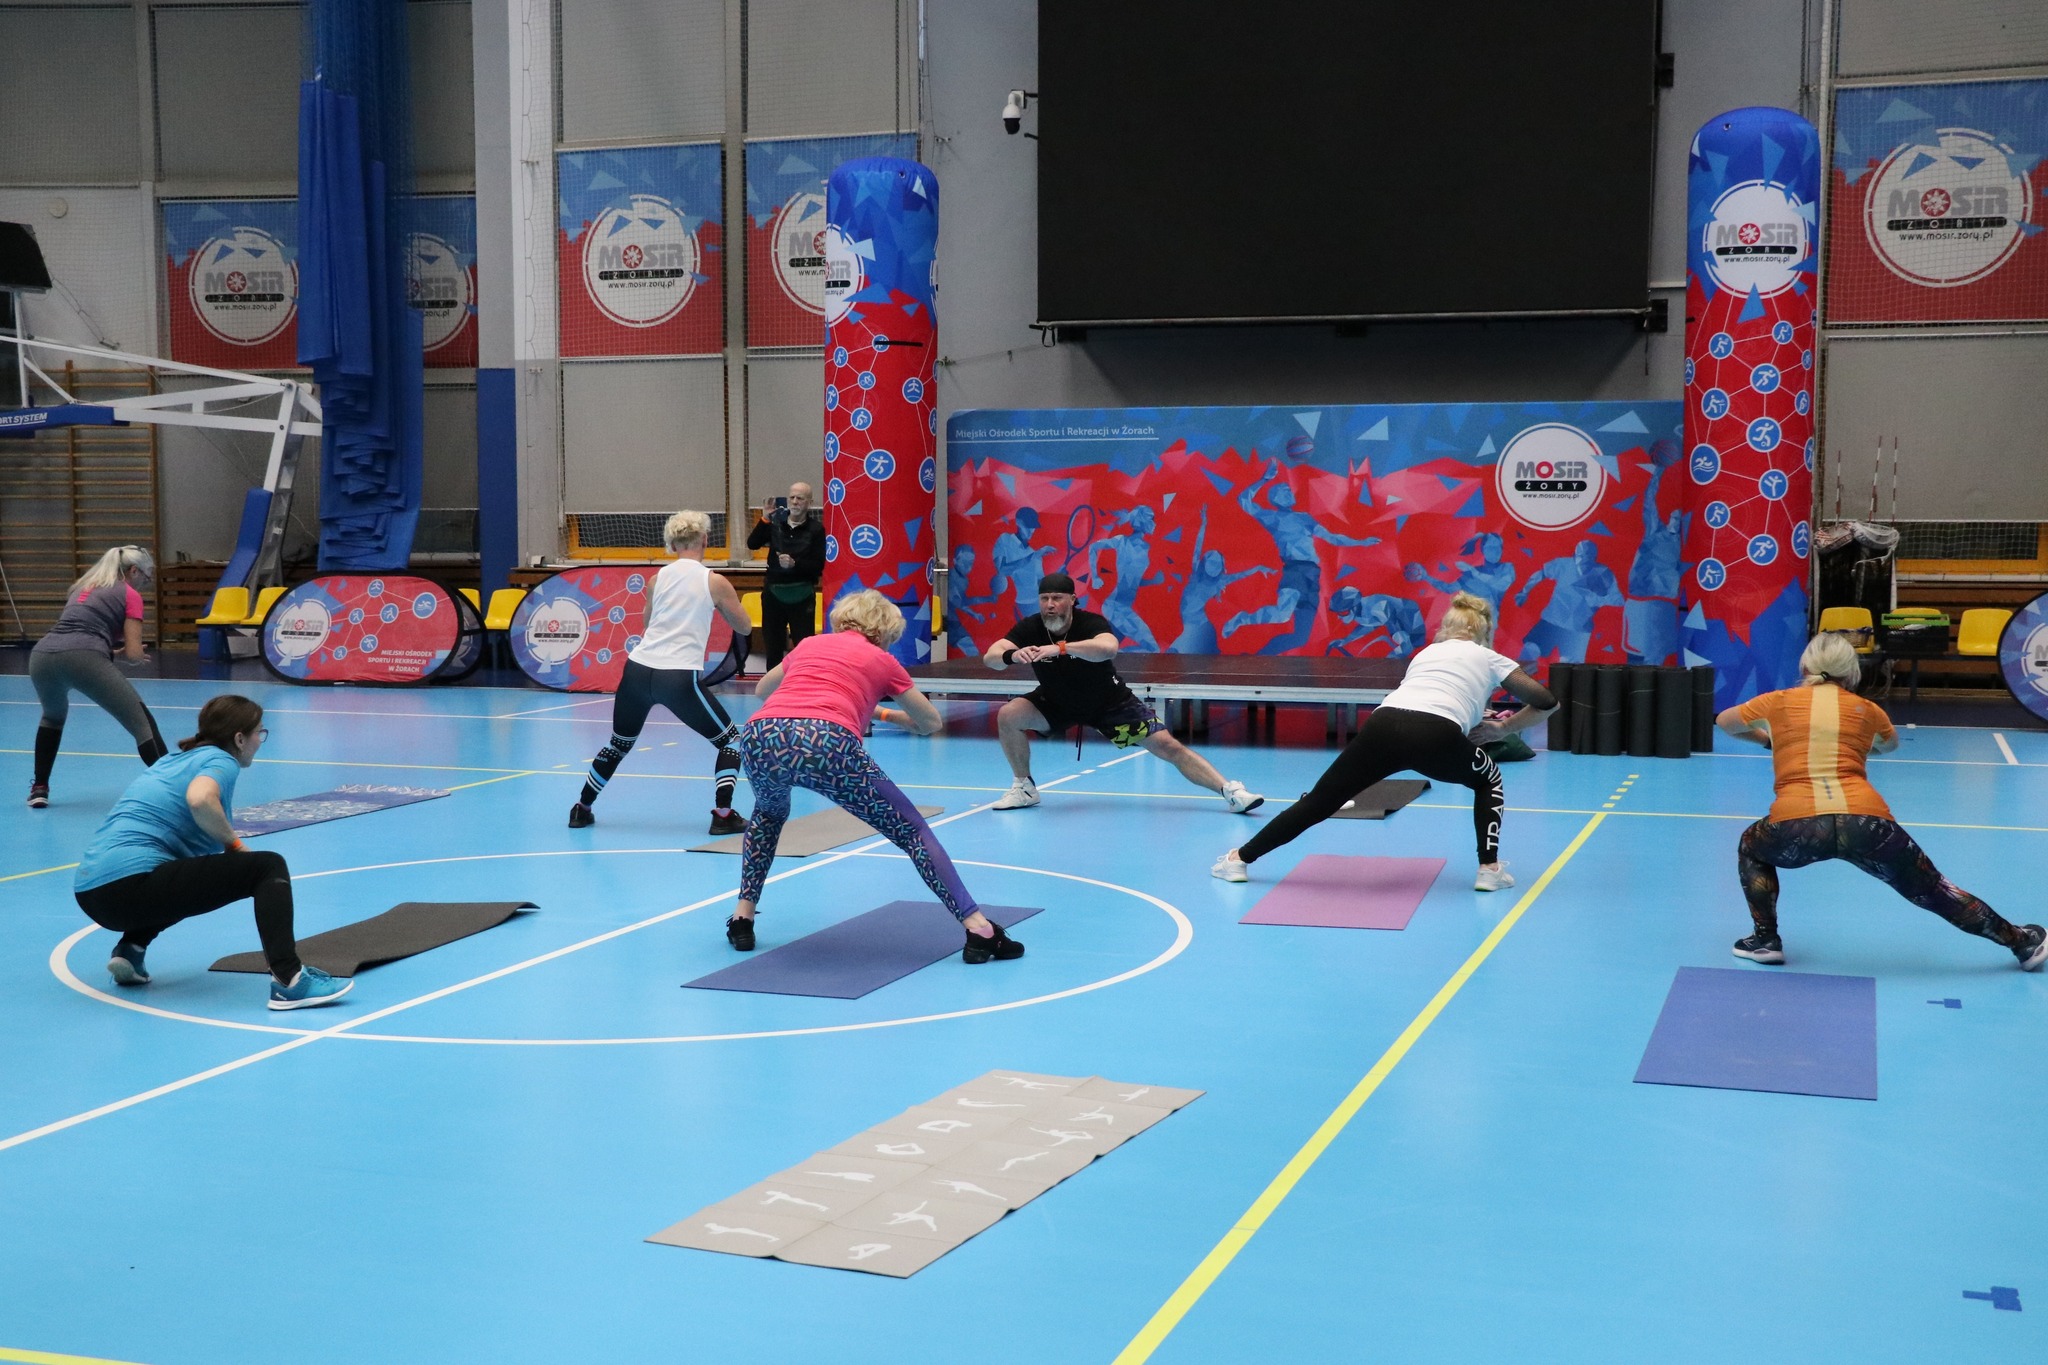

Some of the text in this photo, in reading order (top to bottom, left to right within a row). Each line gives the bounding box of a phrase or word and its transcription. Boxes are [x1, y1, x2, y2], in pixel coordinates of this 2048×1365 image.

[1899, 230, 1993, 241] www.mosir.zory.pl
[1724, 256, 1790, 264] www.mosir.zory.pl
[13, 412, 48, 424] SYSTEM
[955, 429, 987, 439] Miejski
[988, 428, 1027, 437] Ośrodek
[1029, 428, 1059, 438] Sportu
[1062, 427, 1065, 436] i
[1067, 427, 1109, 437] Rekreacji
[1122, 425, 1155, 435] Żorach
[405, 649, 433, 657] OŚRODEK
